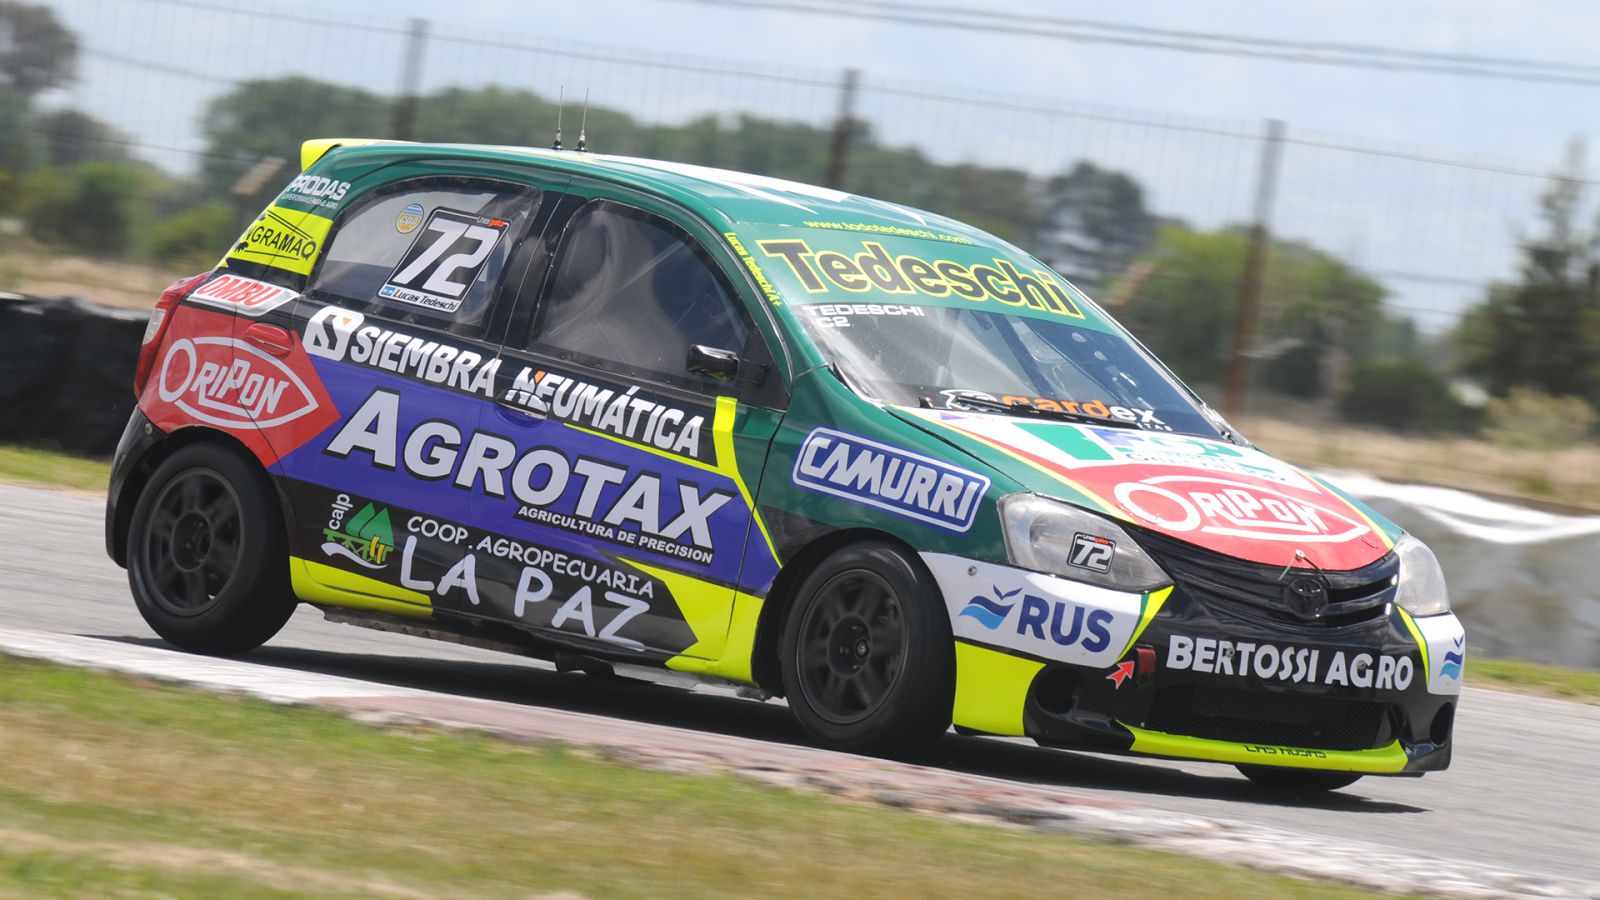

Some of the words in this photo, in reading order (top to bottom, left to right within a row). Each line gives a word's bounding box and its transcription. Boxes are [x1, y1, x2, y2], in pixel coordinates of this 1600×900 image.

[391, 217, 500, 297] 72
[803, 220, 972, 244] www.todotedeschi.com
[195, 275, 282, 306] OMBU
[393, 287, 419, 302] Lucas
[420, 294, 459, 311] Tedeschi
[755, 239, 1085, 320] Tedeschi
[802, 303, 926, 317] TEDESCHI
[815, 315, 851, 328] C2
[350, 326, 502, 397] SIEMBRA
[503, 366, 705, 457] NEUMÁTICA
[325, 389, 733, 550] AGROTAX
[799, 436, 981, 521] CAMURRI
[328, 493, 354, 530] calp
[518, 505, 614, 539] AGRICULTURA
[616, 530, 636, 544] DE
[637, 535, 714, 564] PRECISION
[477, 534, 655, 599] AGROPECUARIA
[1073, 538, 1112, 571] 72
[399, 535, 481, 606] LA
[512, 567, 651, 653] PAZ
[1016, 593, 1115, 654] RUS
[1165, 634, 1320, 683] BERTOSSI
[1324, 650, 1414, 691] AGRO
